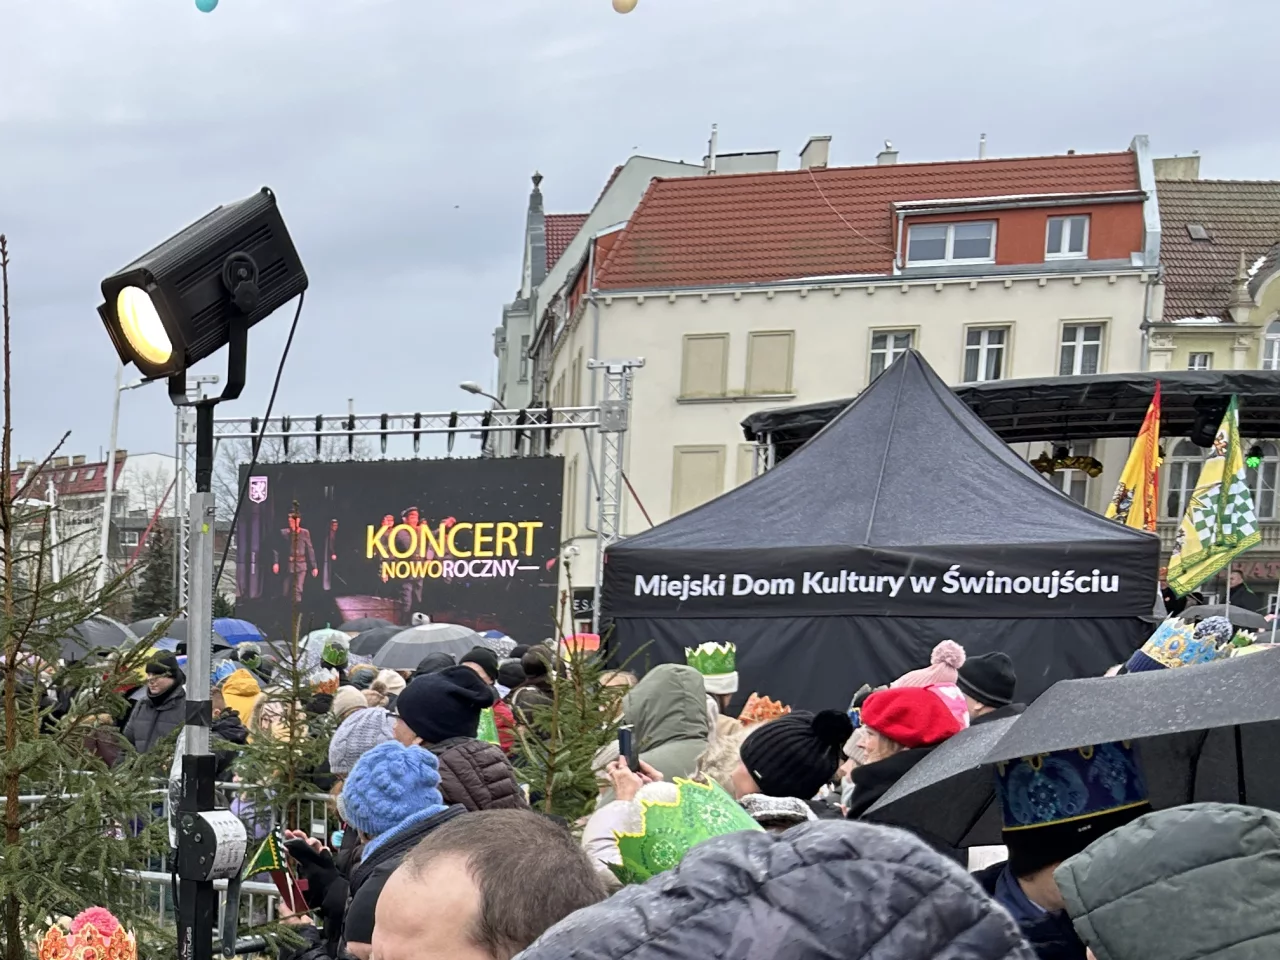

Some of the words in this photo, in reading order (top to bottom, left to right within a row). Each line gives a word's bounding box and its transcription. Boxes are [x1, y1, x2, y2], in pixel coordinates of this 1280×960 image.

[366, 521, 544, 558] KONCERT
[381, 559, 520, 579] NOWOROCZNY
[634, 574, 727, 601] Miejski
[732, 573, 795, 596] Dom
[802, 569, 906, 598] Kultury
[910, 576, 937, 593] w
[942, 564, 1119, 599] Świnoujściu
